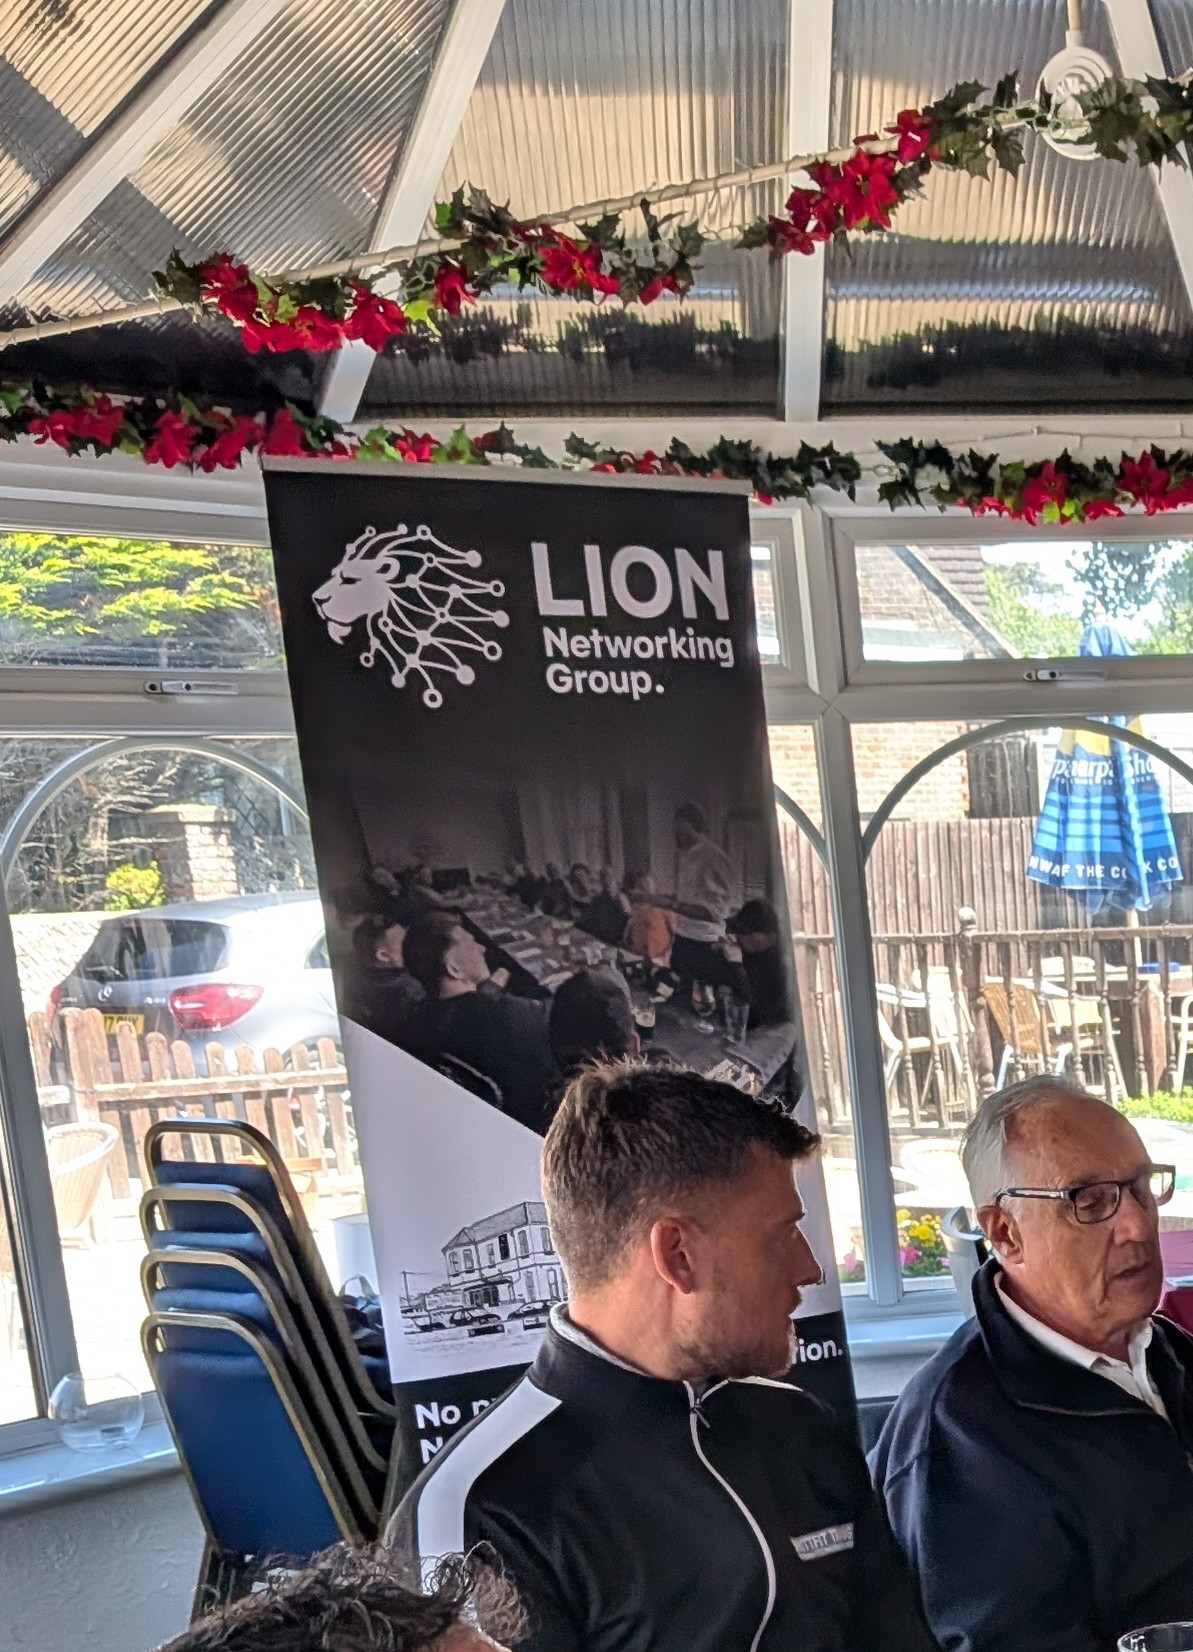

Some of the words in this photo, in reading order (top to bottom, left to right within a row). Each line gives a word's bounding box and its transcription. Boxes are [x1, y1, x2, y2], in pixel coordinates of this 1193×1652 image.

[531, 542, 730, 620] LION
[543, 626, 734, 668] Networking
[546, 663, 666, 701] Group.
[414, 1402, 462, 1430] No
